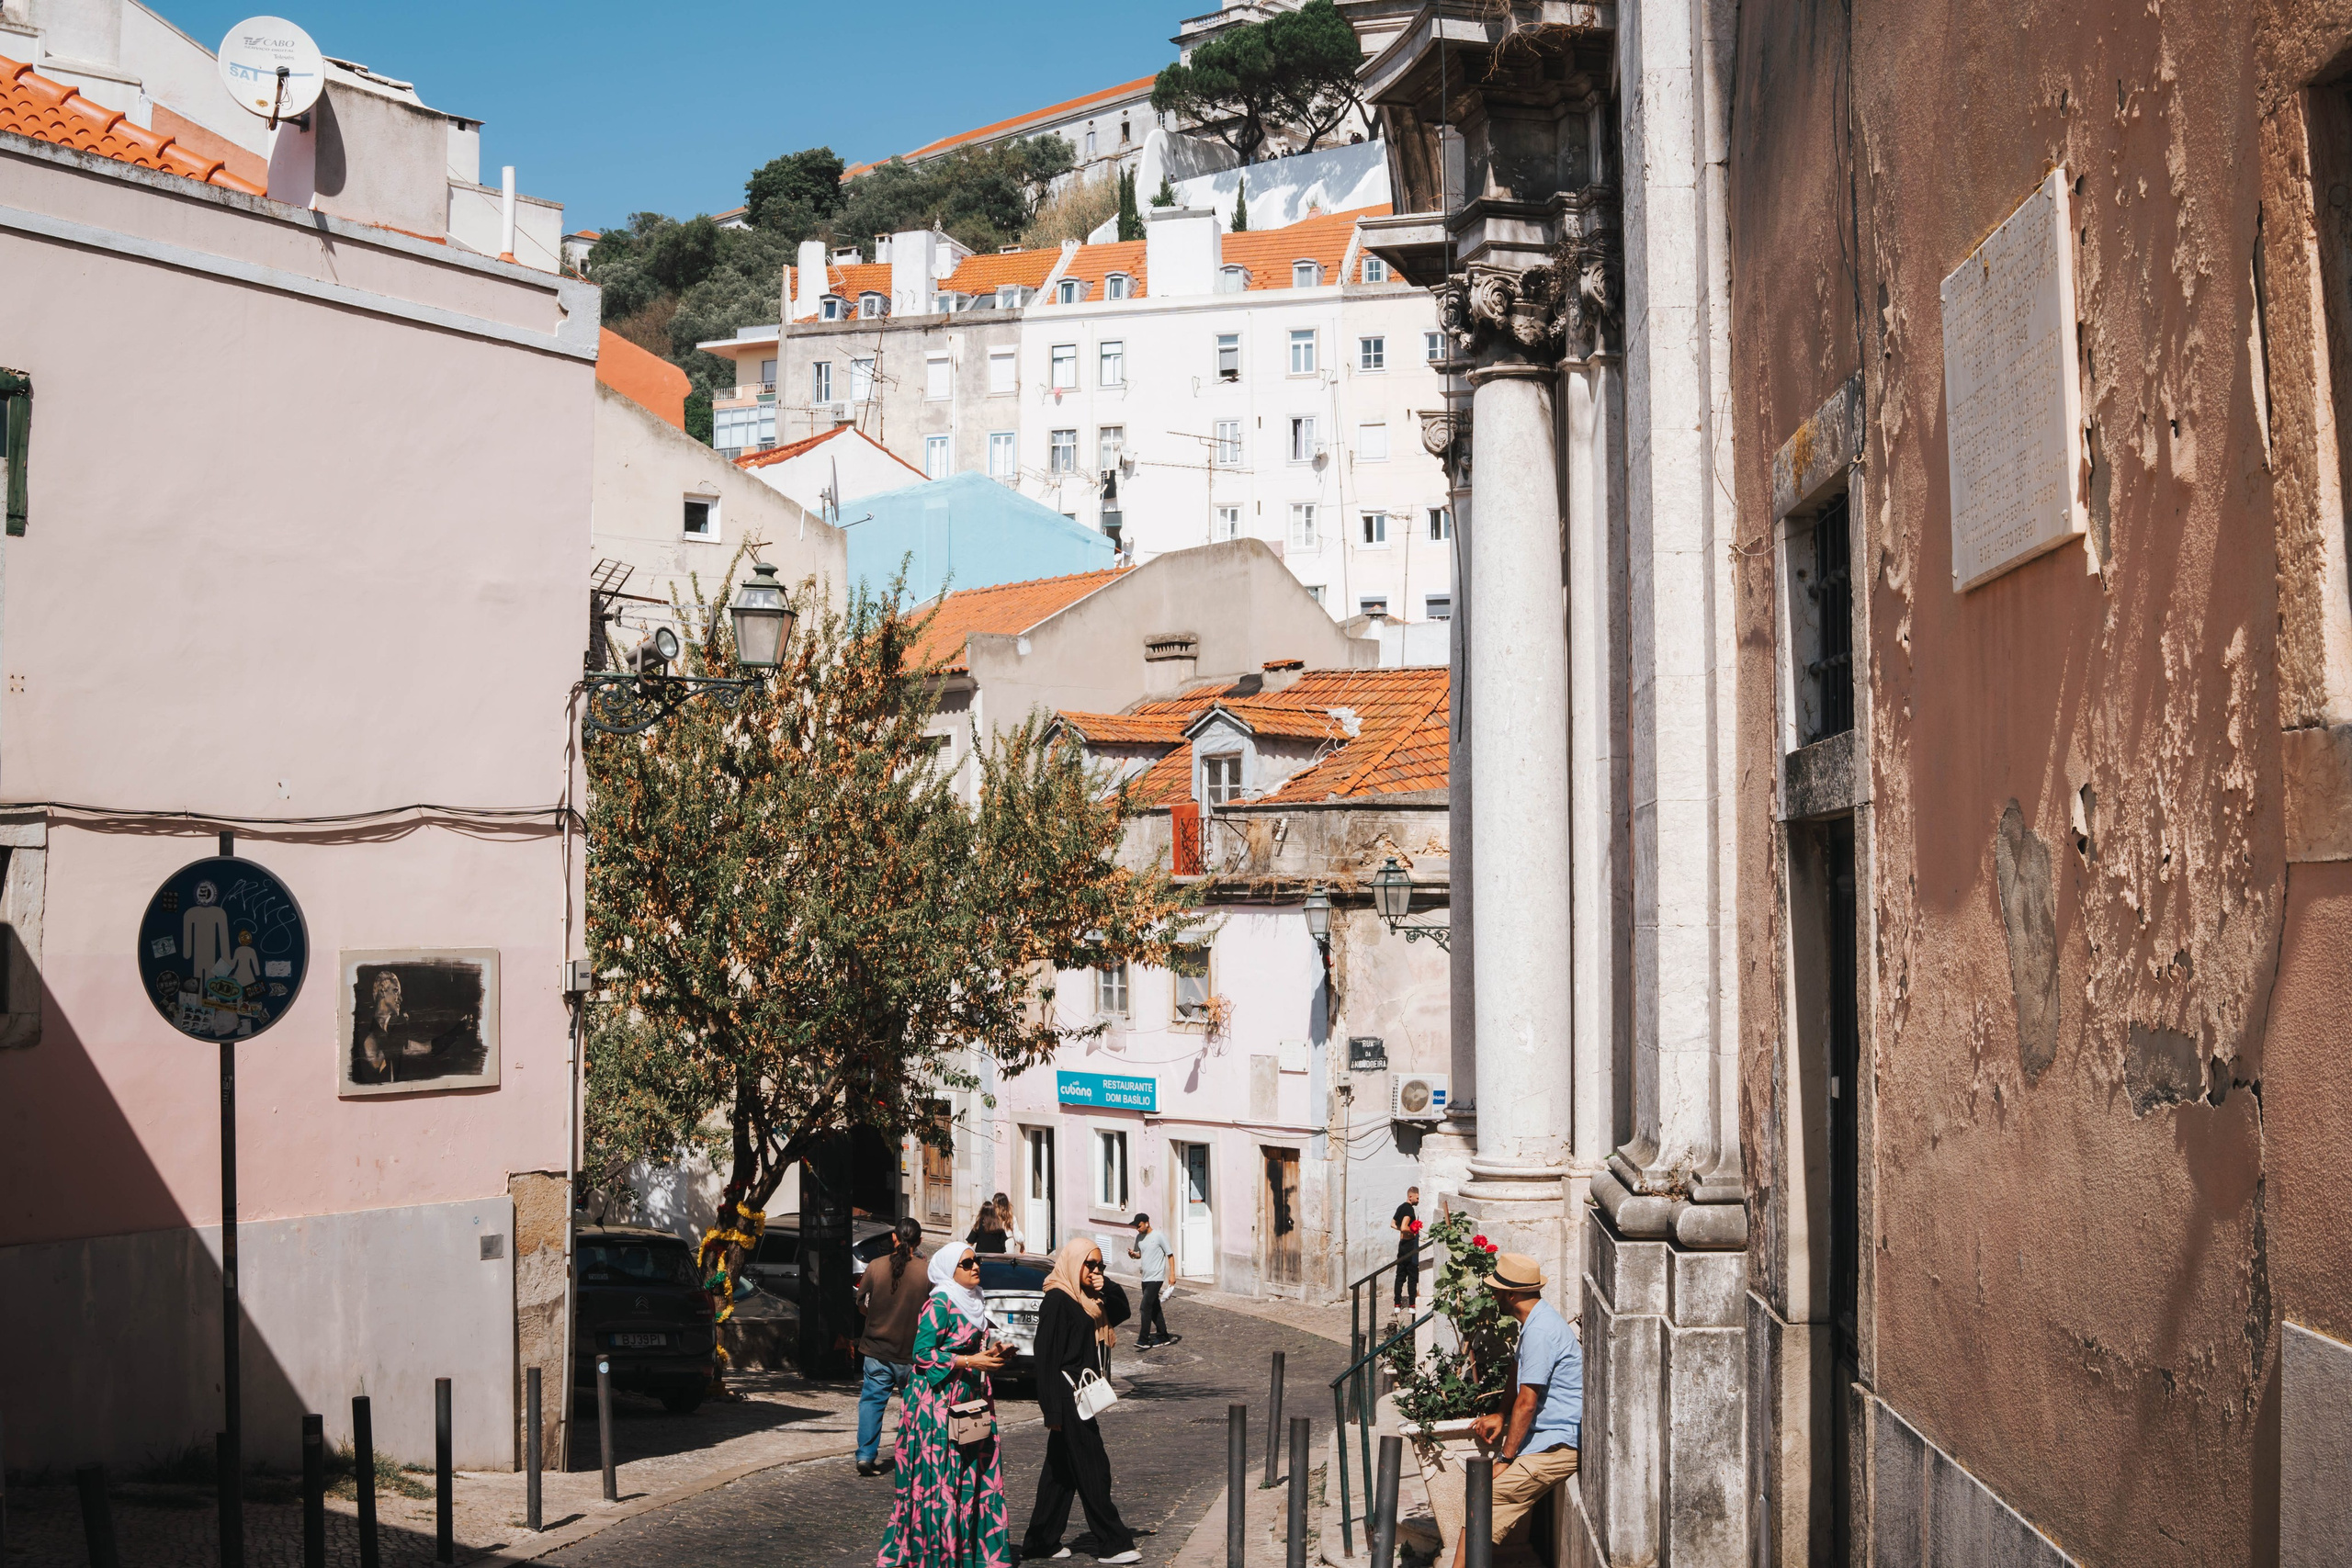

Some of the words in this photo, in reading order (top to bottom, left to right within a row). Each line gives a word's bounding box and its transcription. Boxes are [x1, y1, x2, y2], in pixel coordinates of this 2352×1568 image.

[264, 39, 295, 48] CABO
[230, 63, 259, 82] SAT
[1996, 230, 2027, 274] COMPANHIA
[2036, 203, 2055, 236] JESUS
[2007, 253, 2028, 286] MUNDO
[1975, 307, 1993, 336] POSSE
[1962, 344, 1973, 368] COM
[1983, 342, 2004, 374] JANEIRO
[2009, 344, 2035, 380] PRIMEIRO
[2010, 498, 2025, 522] ESTA
[1991, 530, 2013, 558] JANEIRO
[1060, 1084, 1092, 1098] cubano
[1102, 1079, 1153, 1093] RESTAURANTE
[1105, 1093, 1122, 1103] DOM
[1123, 1093, 1150, 1106] BASÍLIO
[1021, 1314, 1032, 1323] 78
